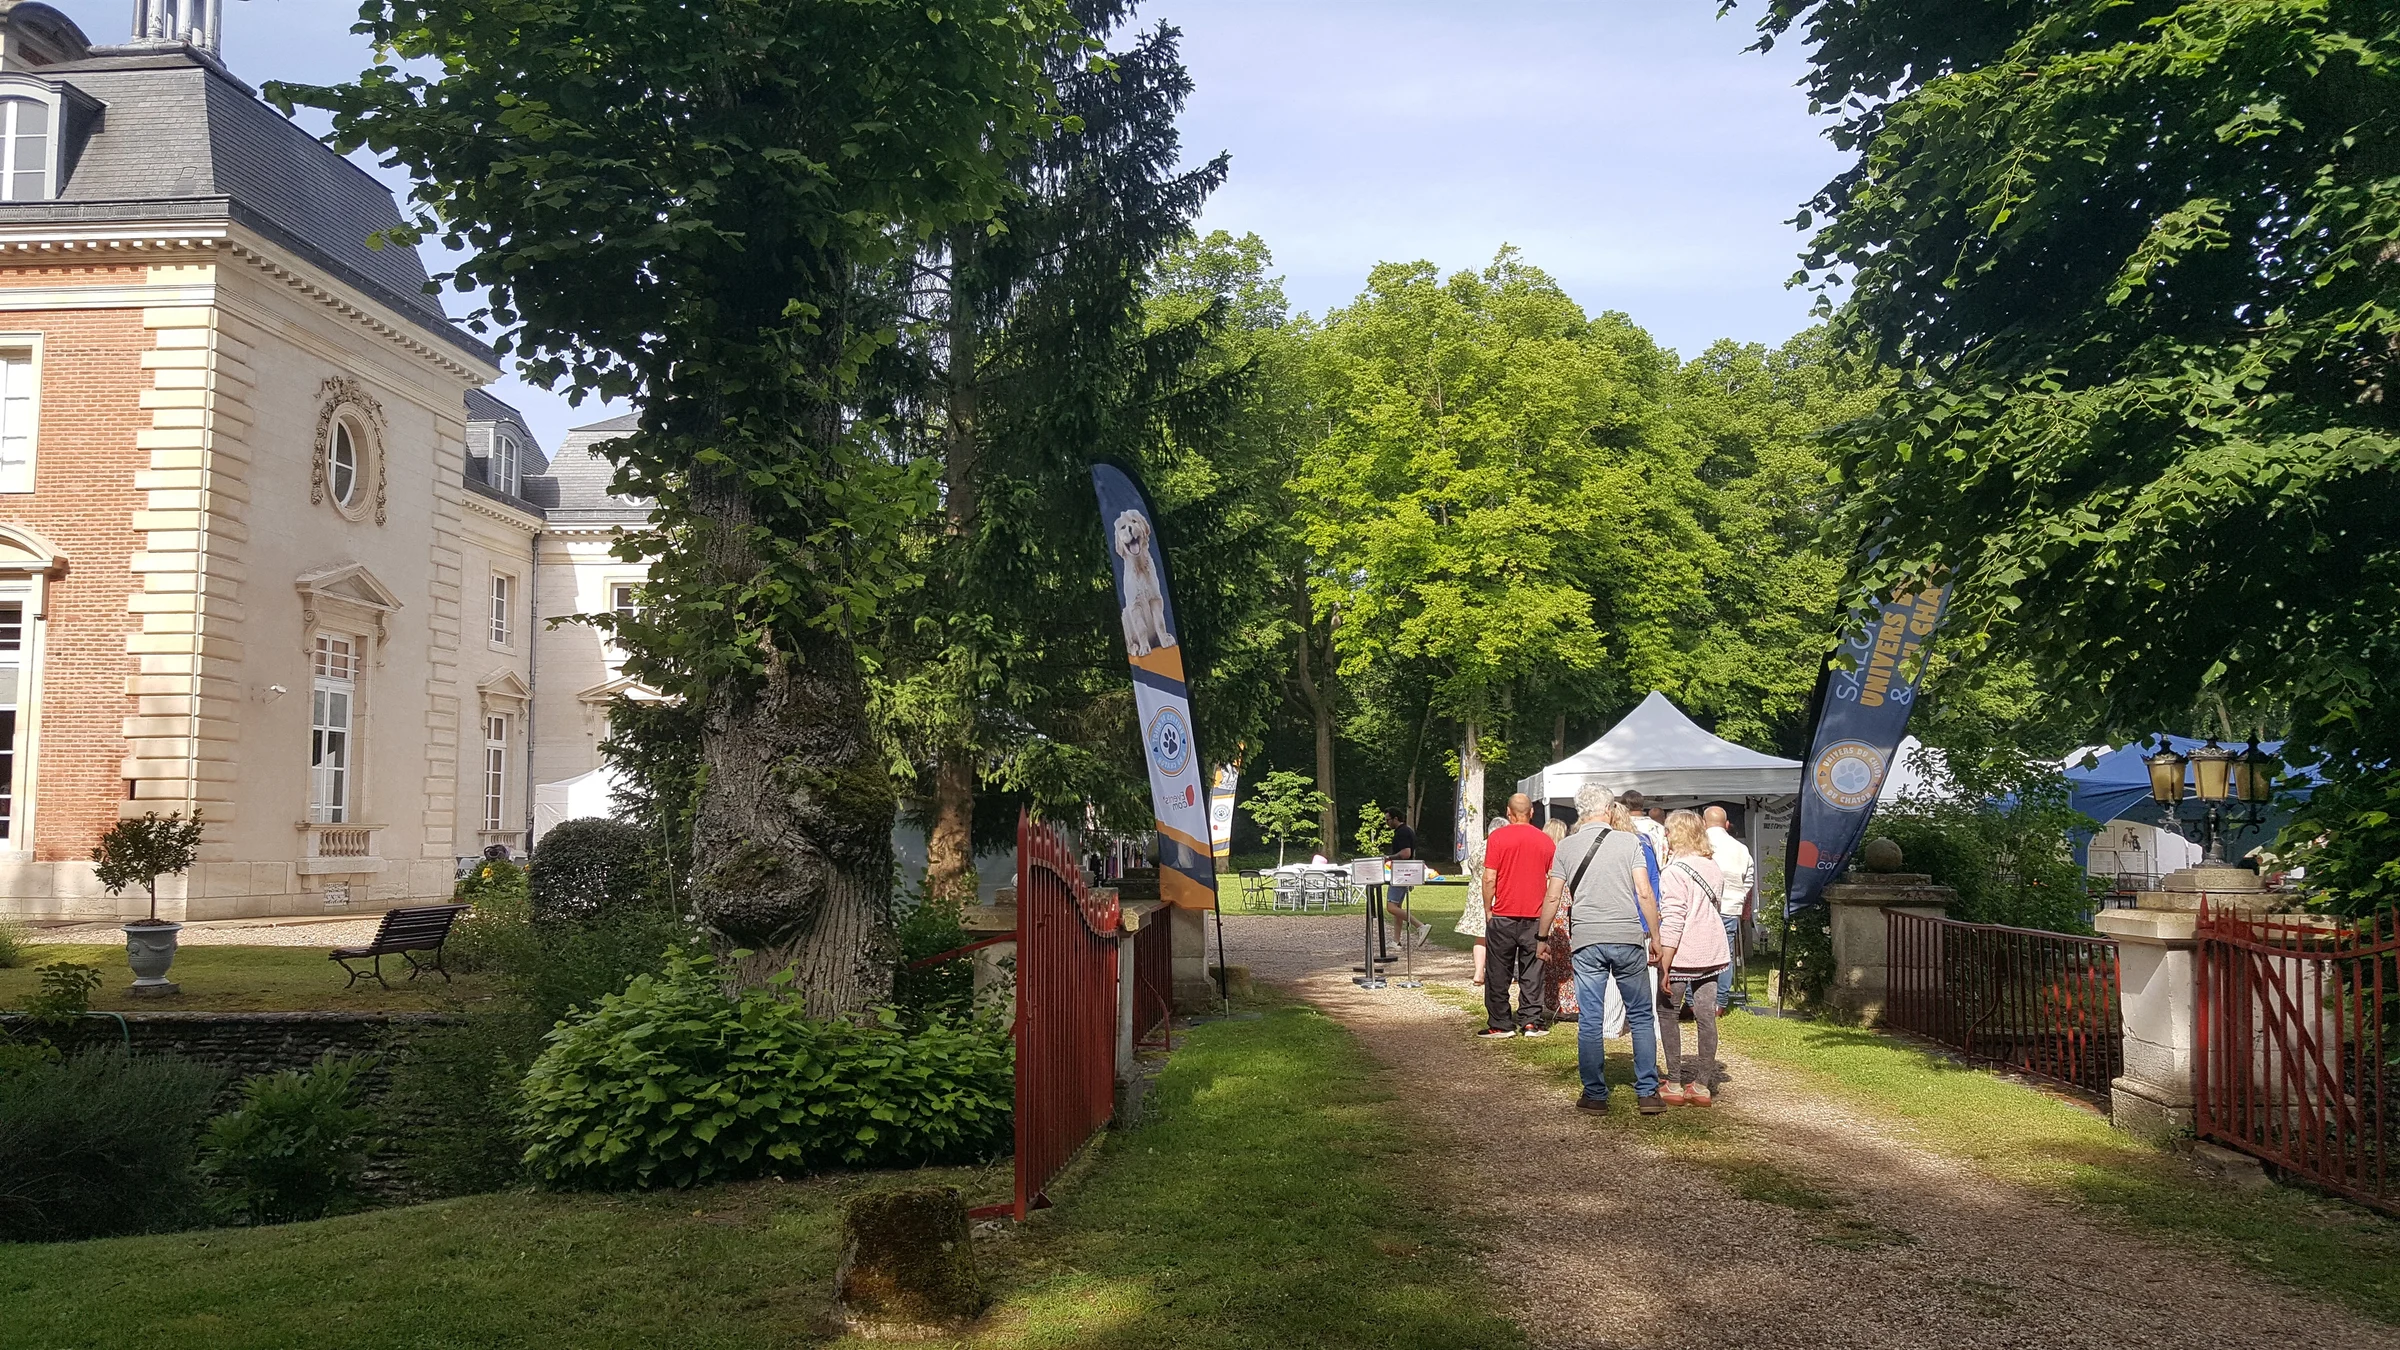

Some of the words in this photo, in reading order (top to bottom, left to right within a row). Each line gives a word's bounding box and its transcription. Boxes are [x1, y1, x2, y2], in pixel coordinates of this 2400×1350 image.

[1860, 612, 1907, 707] UNIVERS
[1890, 686, 1913, 705] &
[1822, 747, 1854, 767] UNIVERS
[1856, 748, 1869, 757] DU
[1869, 757, 1882, 778] CHIOT
[1826, 789, 1839, 800] DU
[1840, 792, 1872, 804] CHATON
